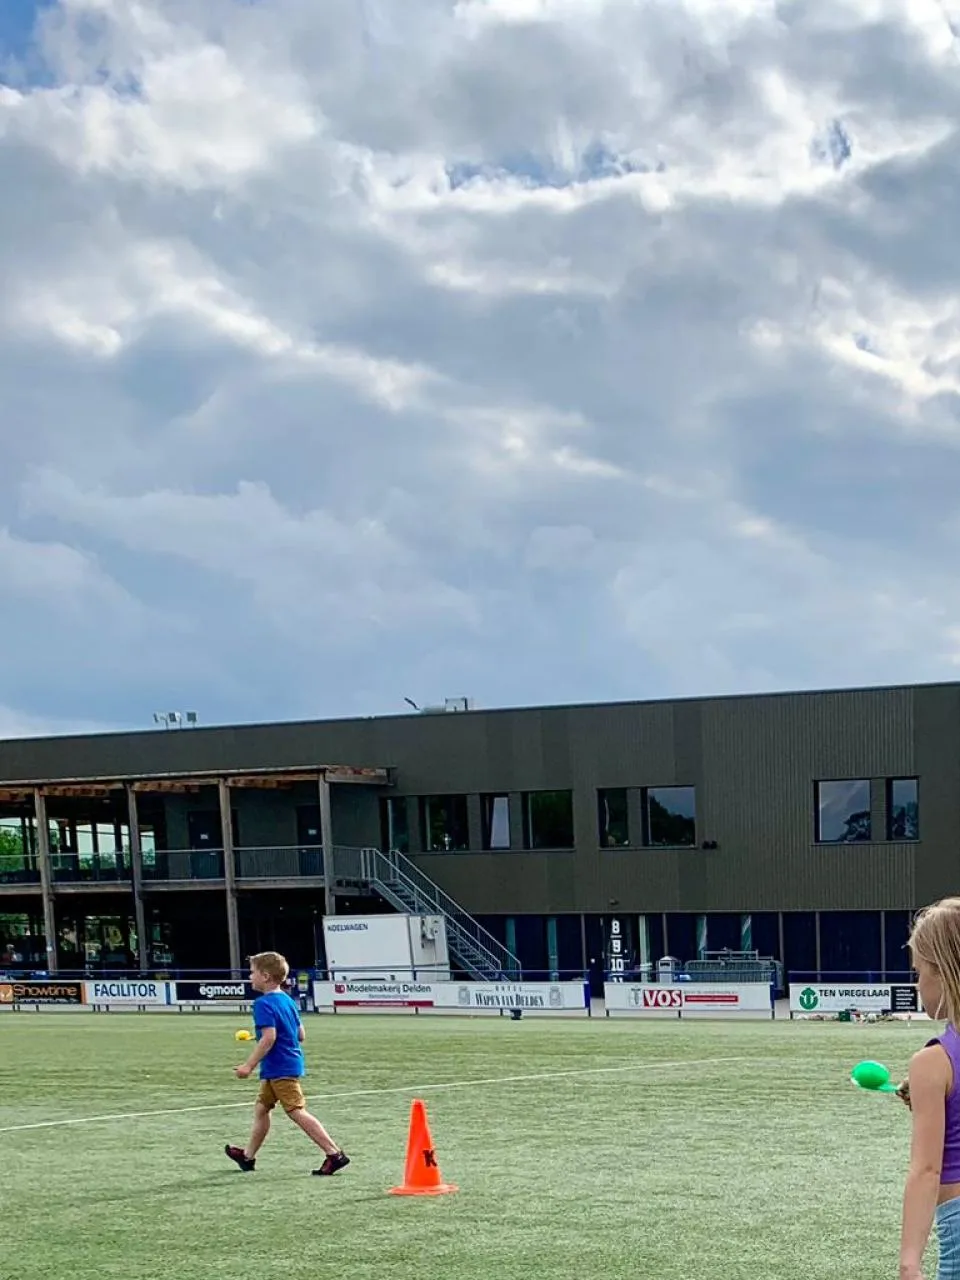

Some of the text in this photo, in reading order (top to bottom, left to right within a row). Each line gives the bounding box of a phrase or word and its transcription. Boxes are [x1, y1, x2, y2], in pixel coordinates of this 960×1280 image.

[612, 920, 620, 934] 8
[612, 939, 621, 953] 9
[611, 958, 624, 971] 10
[14, 984, 77, 996] Showtime
[94, 983, 157, 997] FACILITOR
[402, 984, 431, 993] Delden
[819, 989, 889, 997] TEN VREGELAAR
[644, 990, 681, 1006] VOS
[423, 1150, 437, 1167] K
